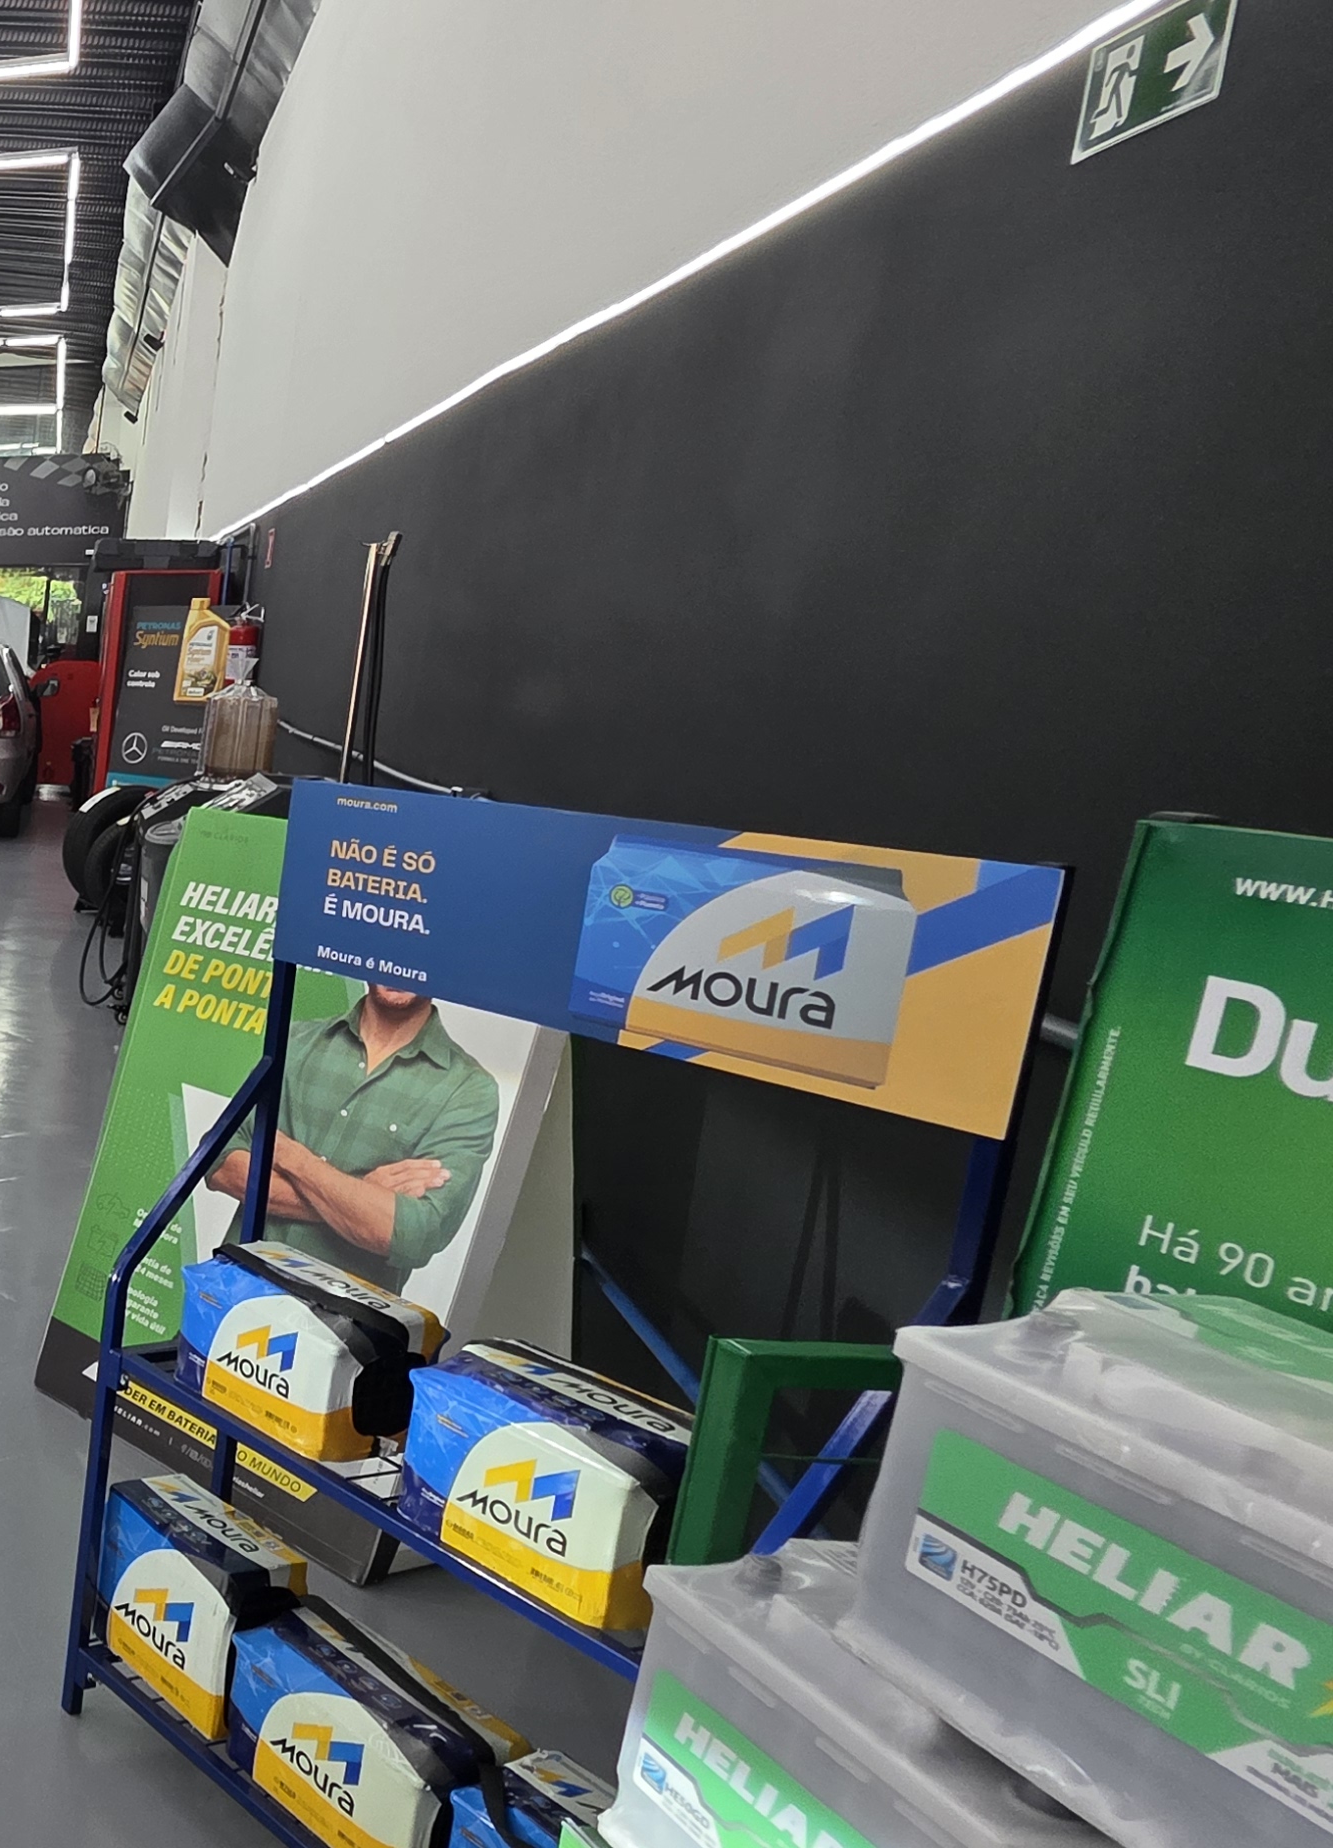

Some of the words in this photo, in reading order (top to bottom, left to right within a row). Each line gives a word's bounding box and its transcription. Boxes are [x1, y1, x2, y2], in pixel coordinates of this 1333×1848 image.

[27, 525, 109, 536] automatica
[134, 630, 179, 649] Syntium
[137, 622, 181, 630] PETRONAS
[152, 748, 198, 757] PETRONA
[336, 797, 398, 813] moura.com
[330, 838, 377, 865] NÃO
[382, 845, 397, 868] É
[402, 851, 436, 874] SÓ
[327, 868, 428, 904] BATERIA.
[323, 893, 338, 915] É
[341, 900, 430, 935] MOURA.
[171, 915, 275, 962] EXCELÊ
[162, 949, 204, 980] DE
[201, 958, 273, 999] PONT
[317, 945, 363, 967] Moura
[365, 957, 375, 970] é
[378, 959, 428, 982] Moura
[153, 983, 176, 1009] A
[177, 988, 267, 1036] PONTA
[1065, 1181, 1079, 1205] SEU
[1138, 1214, 1200, 1265] Há
[1218, 1242, 1275, 1289] 90
[124, 1388, 147, 1406] DER
[149, 1399, 166, 1416] EM
[167, 1409, 216, 1445] BATERIA
[250, 1456, 301, 1494] MUNDO
[960, 1559, 1028, 1608] H75PD
[998, 1491, 1312, 1690] HELIAR
[1123, 1657, 1181, 1710] SLI
